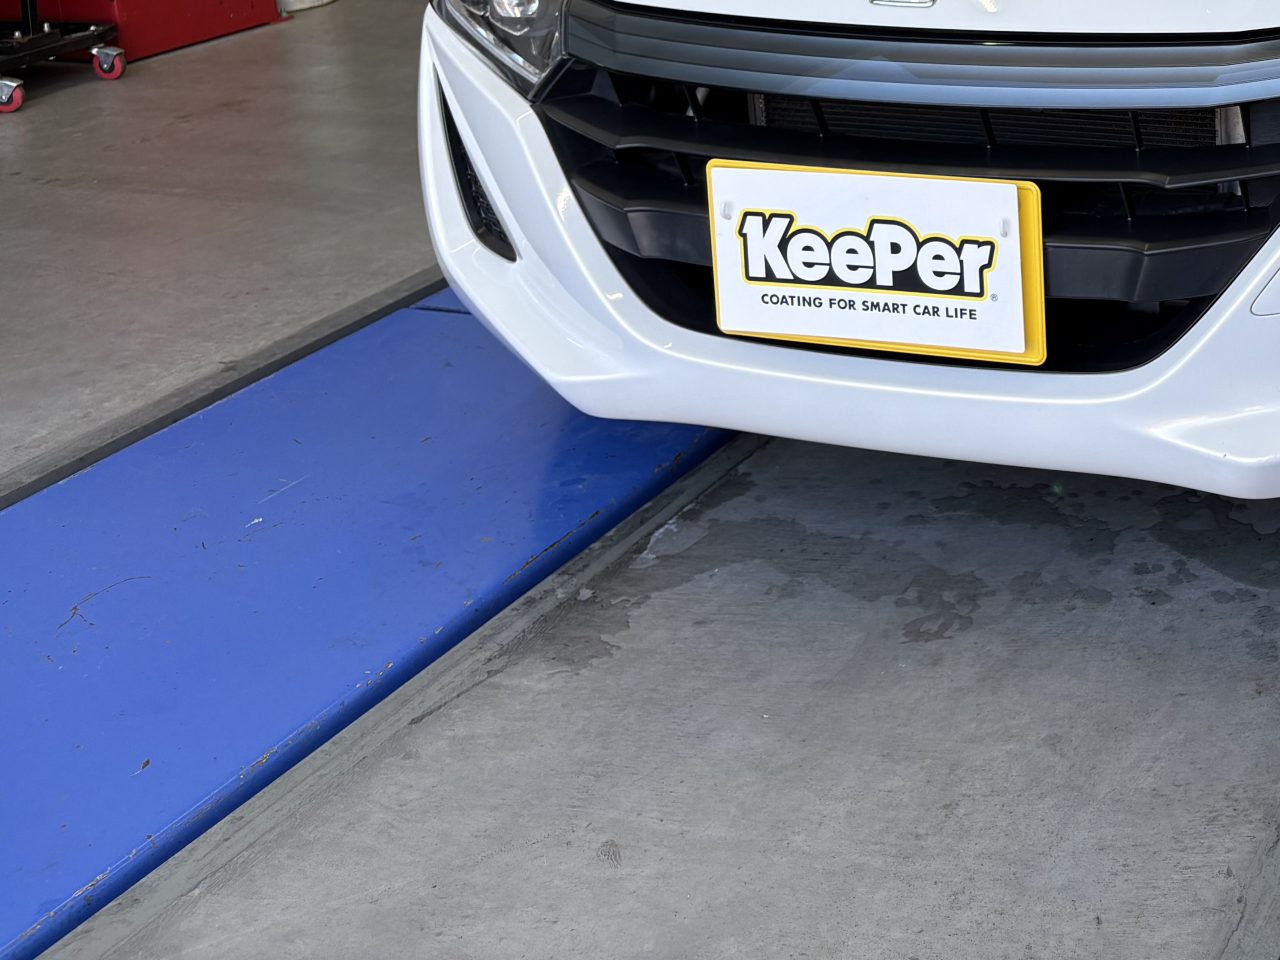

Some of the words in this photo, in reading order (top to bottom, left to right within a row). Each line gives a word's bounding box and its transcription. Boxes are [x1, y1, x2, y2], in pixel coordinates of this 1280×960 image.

[739, 211, 995, 298] KeePer
[761, 293, 823, 308] COATING
[829, 298, 856, 310] FOR
[862, 300, 908, 315] SMART
[913, 304, 941, 318] CAR
[945, 307, 978, 320] LIFE
